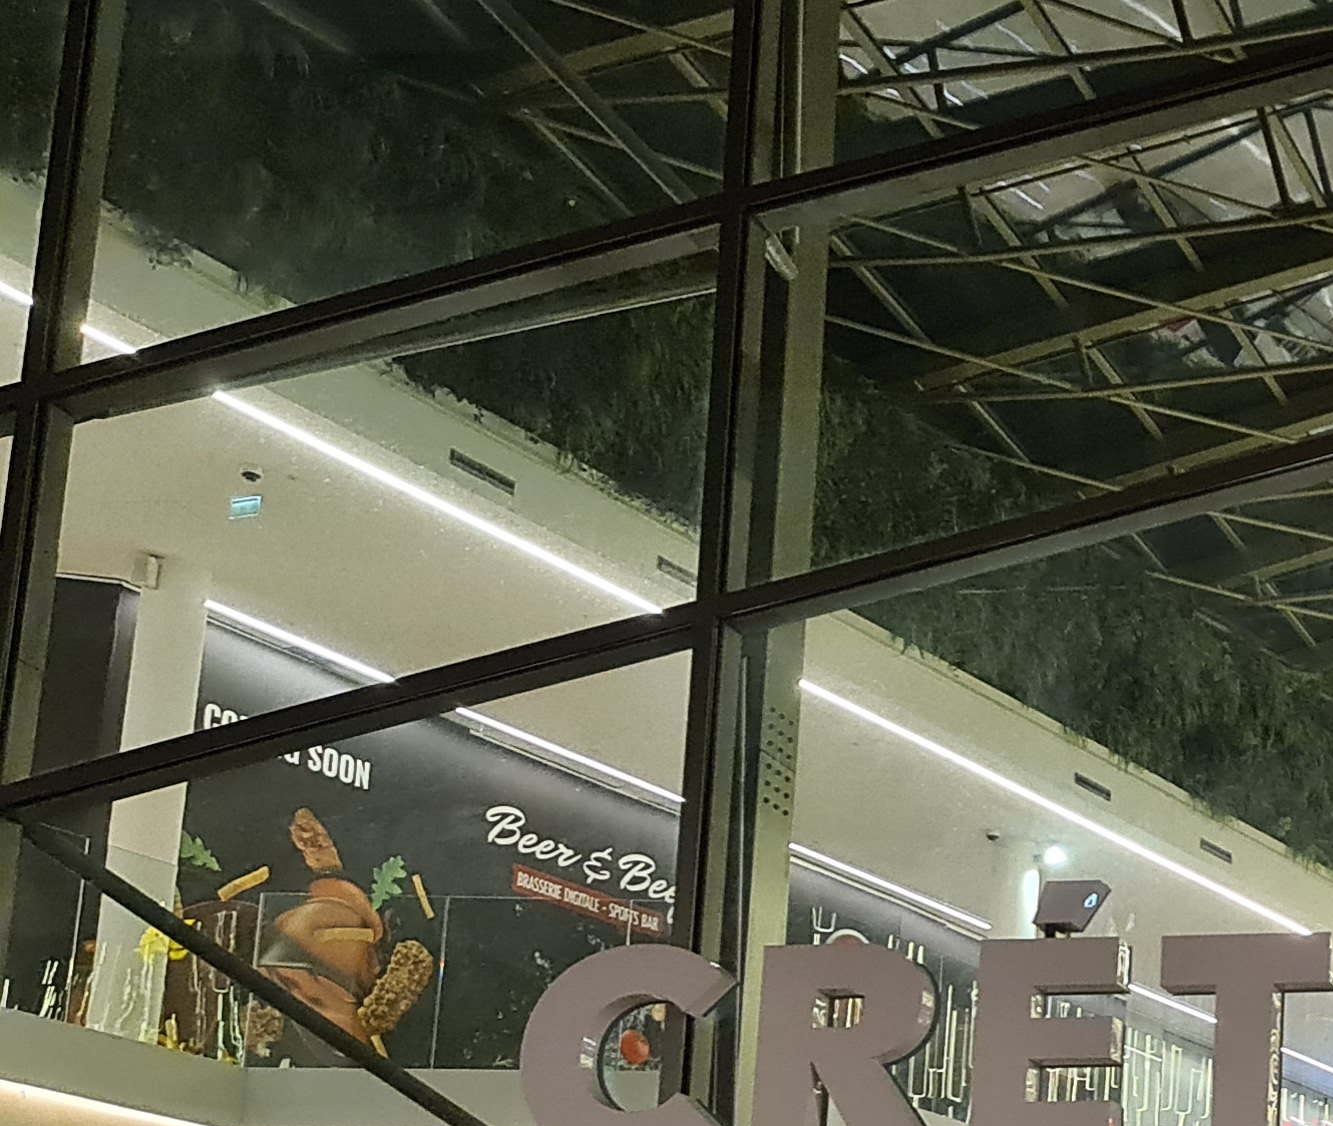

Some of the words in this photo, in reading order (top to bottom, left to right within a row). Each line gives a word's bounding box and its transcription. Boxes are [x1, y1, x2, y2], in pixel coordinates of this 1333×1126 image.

[307, 745, 371, 790] SOON
[485, 805, 582, 867] Beer
[582, 847, 614, 885] &
[618, 853, 676, 917] Bee
[515, 871, 563, 900] BRASSERIE
[563, 885, 601, 913] DIGITALE
[640, 913, 660, 931] BAR
